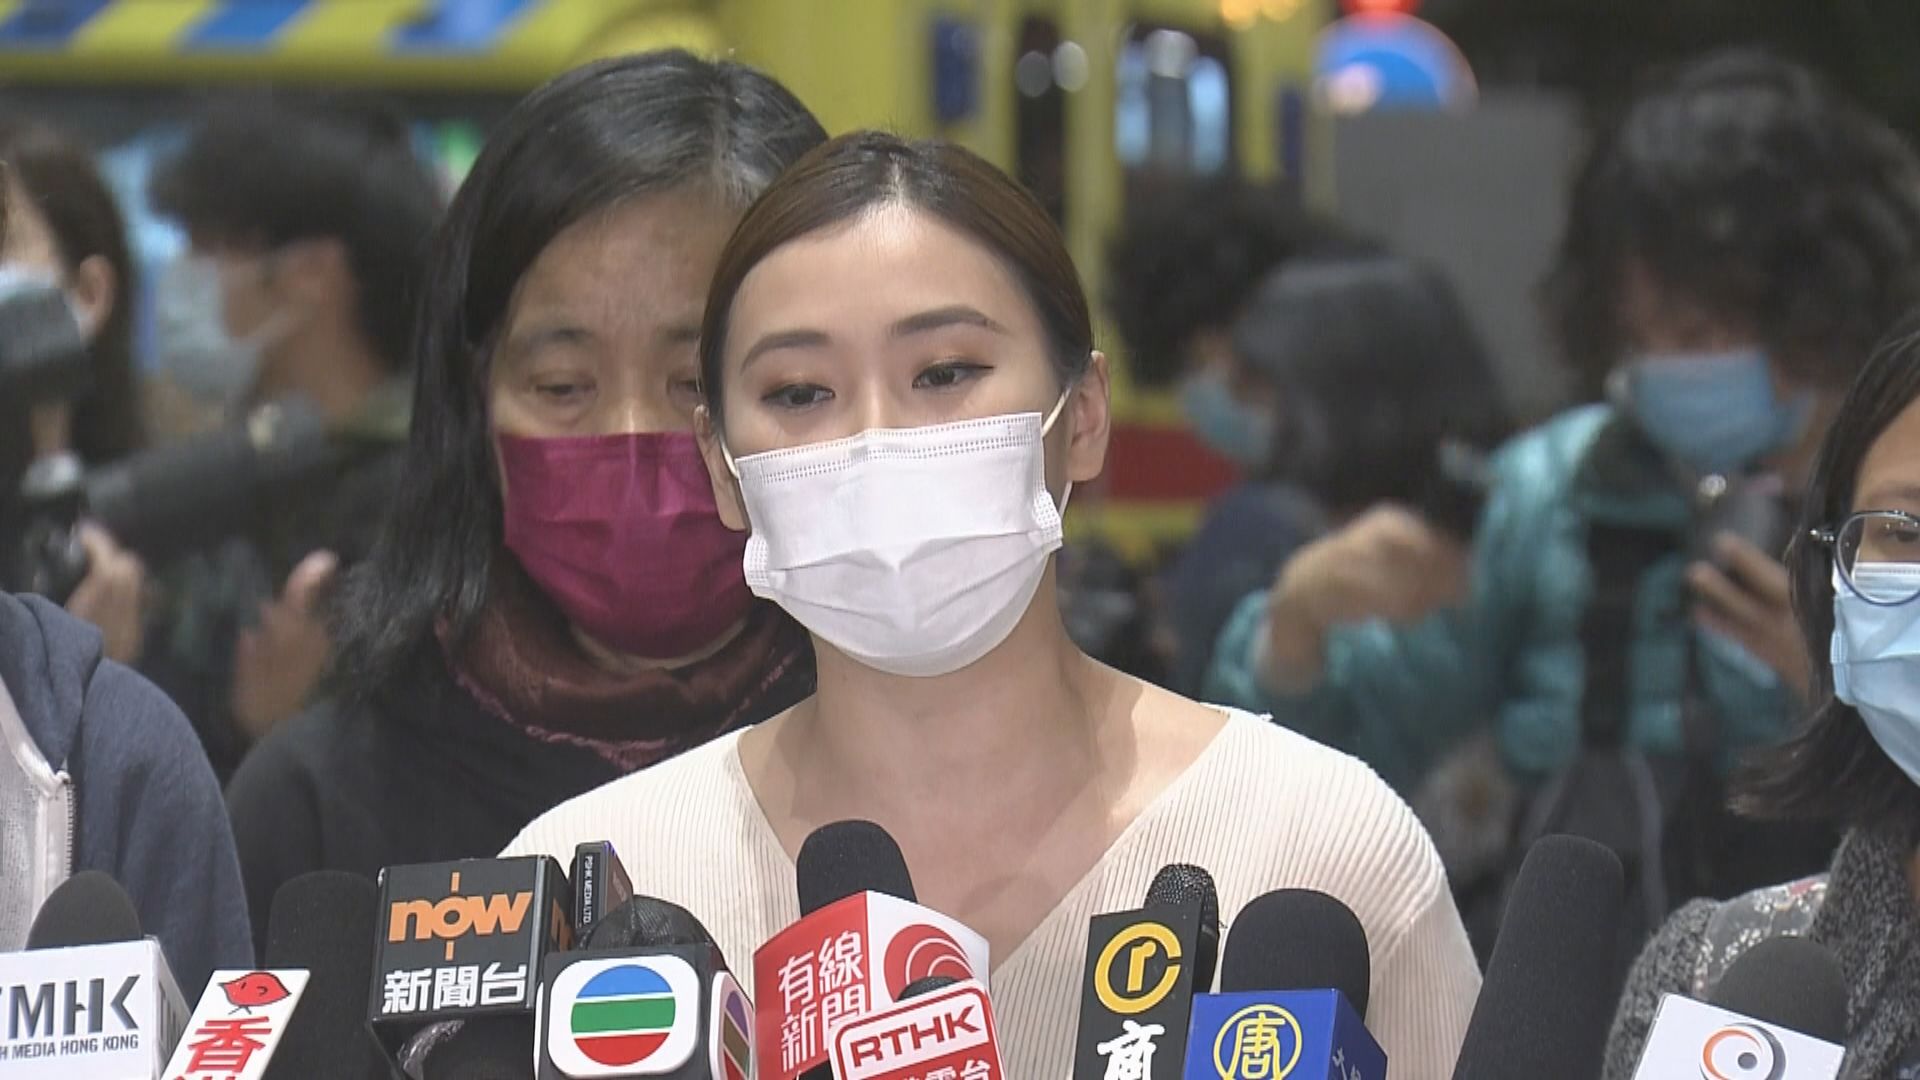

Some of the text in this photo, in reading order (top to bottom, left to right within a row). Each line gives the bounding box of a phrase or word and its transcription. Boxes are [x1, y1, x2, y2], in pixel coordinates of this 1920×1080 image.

[388, 891, 533, 943] now
[583, 879, 593, 907] MEDIA
[383, 961, 528, 1014] 新聞台
[778, 930, 864, 1014] 有線
[0, 974, 141, 1040] MHK
[850, 1004, 981, 1068] RTHK
[12, 1041, 56, 1058] MEDIA
[61, 1038, 98, 1055] HONG
[103, 1034, 139, 1050] KONG
[175, 1015, 272, 1080] 香
[1097, 1020, 1165, 1080] 商
[1223, 1010, 1288, 1080] 唐
